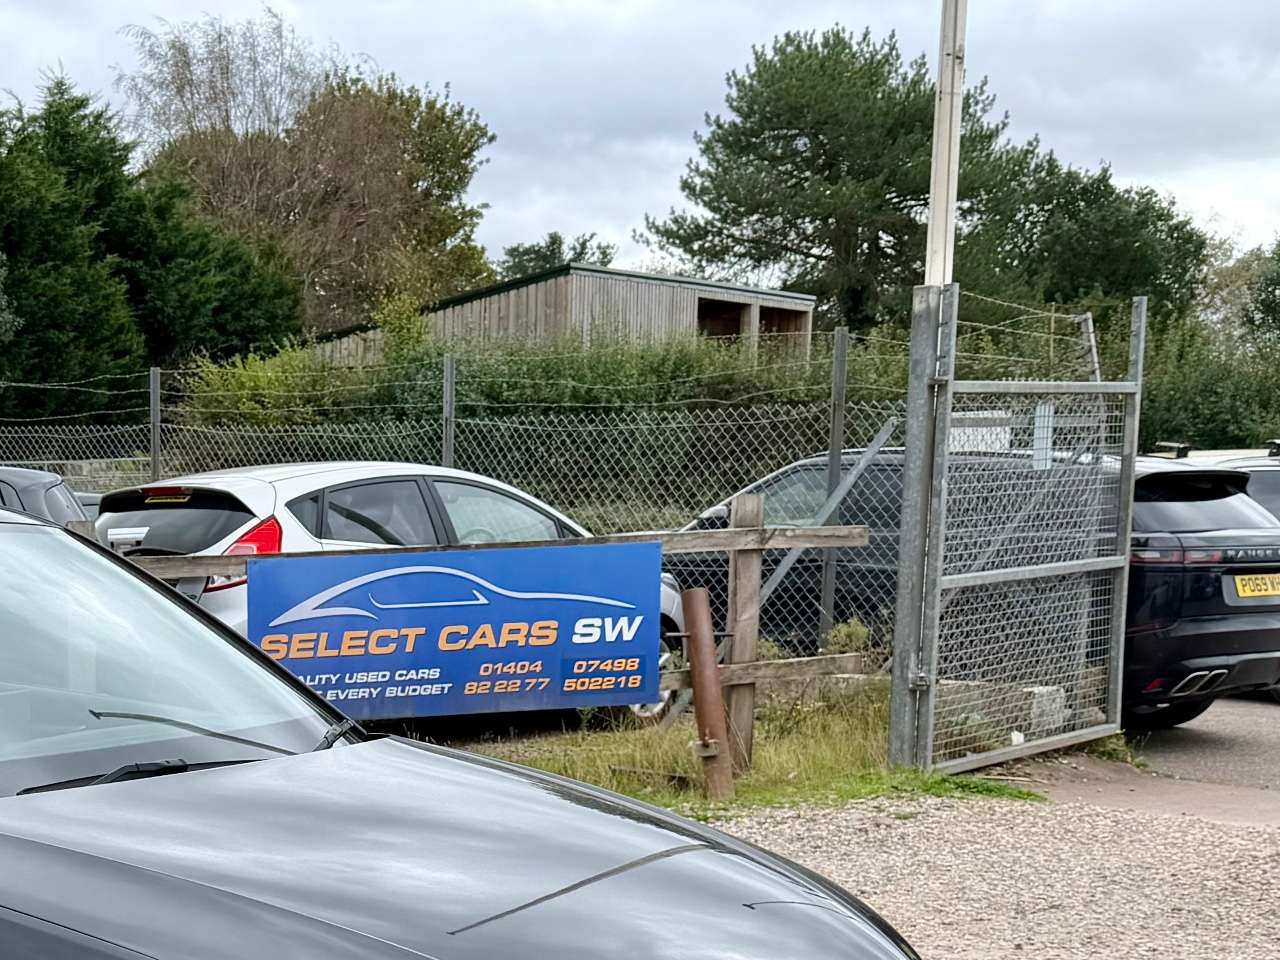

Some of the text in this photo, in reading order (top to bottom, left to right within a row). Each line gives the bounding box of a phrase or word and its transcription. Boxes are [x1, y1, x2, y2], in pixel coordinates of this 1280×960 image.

[260, 615, 645, 661] SELECT CARS SW
[479, 660, 543, 676] 01404
[573, 657, 640, 674] 07498
[344, 671, 390, 684] USED
[394, 668, 441, 681] CARS
[563, 675, 643, 691] 502218
[326, 683, 453, 701] EVERY BUDGET
